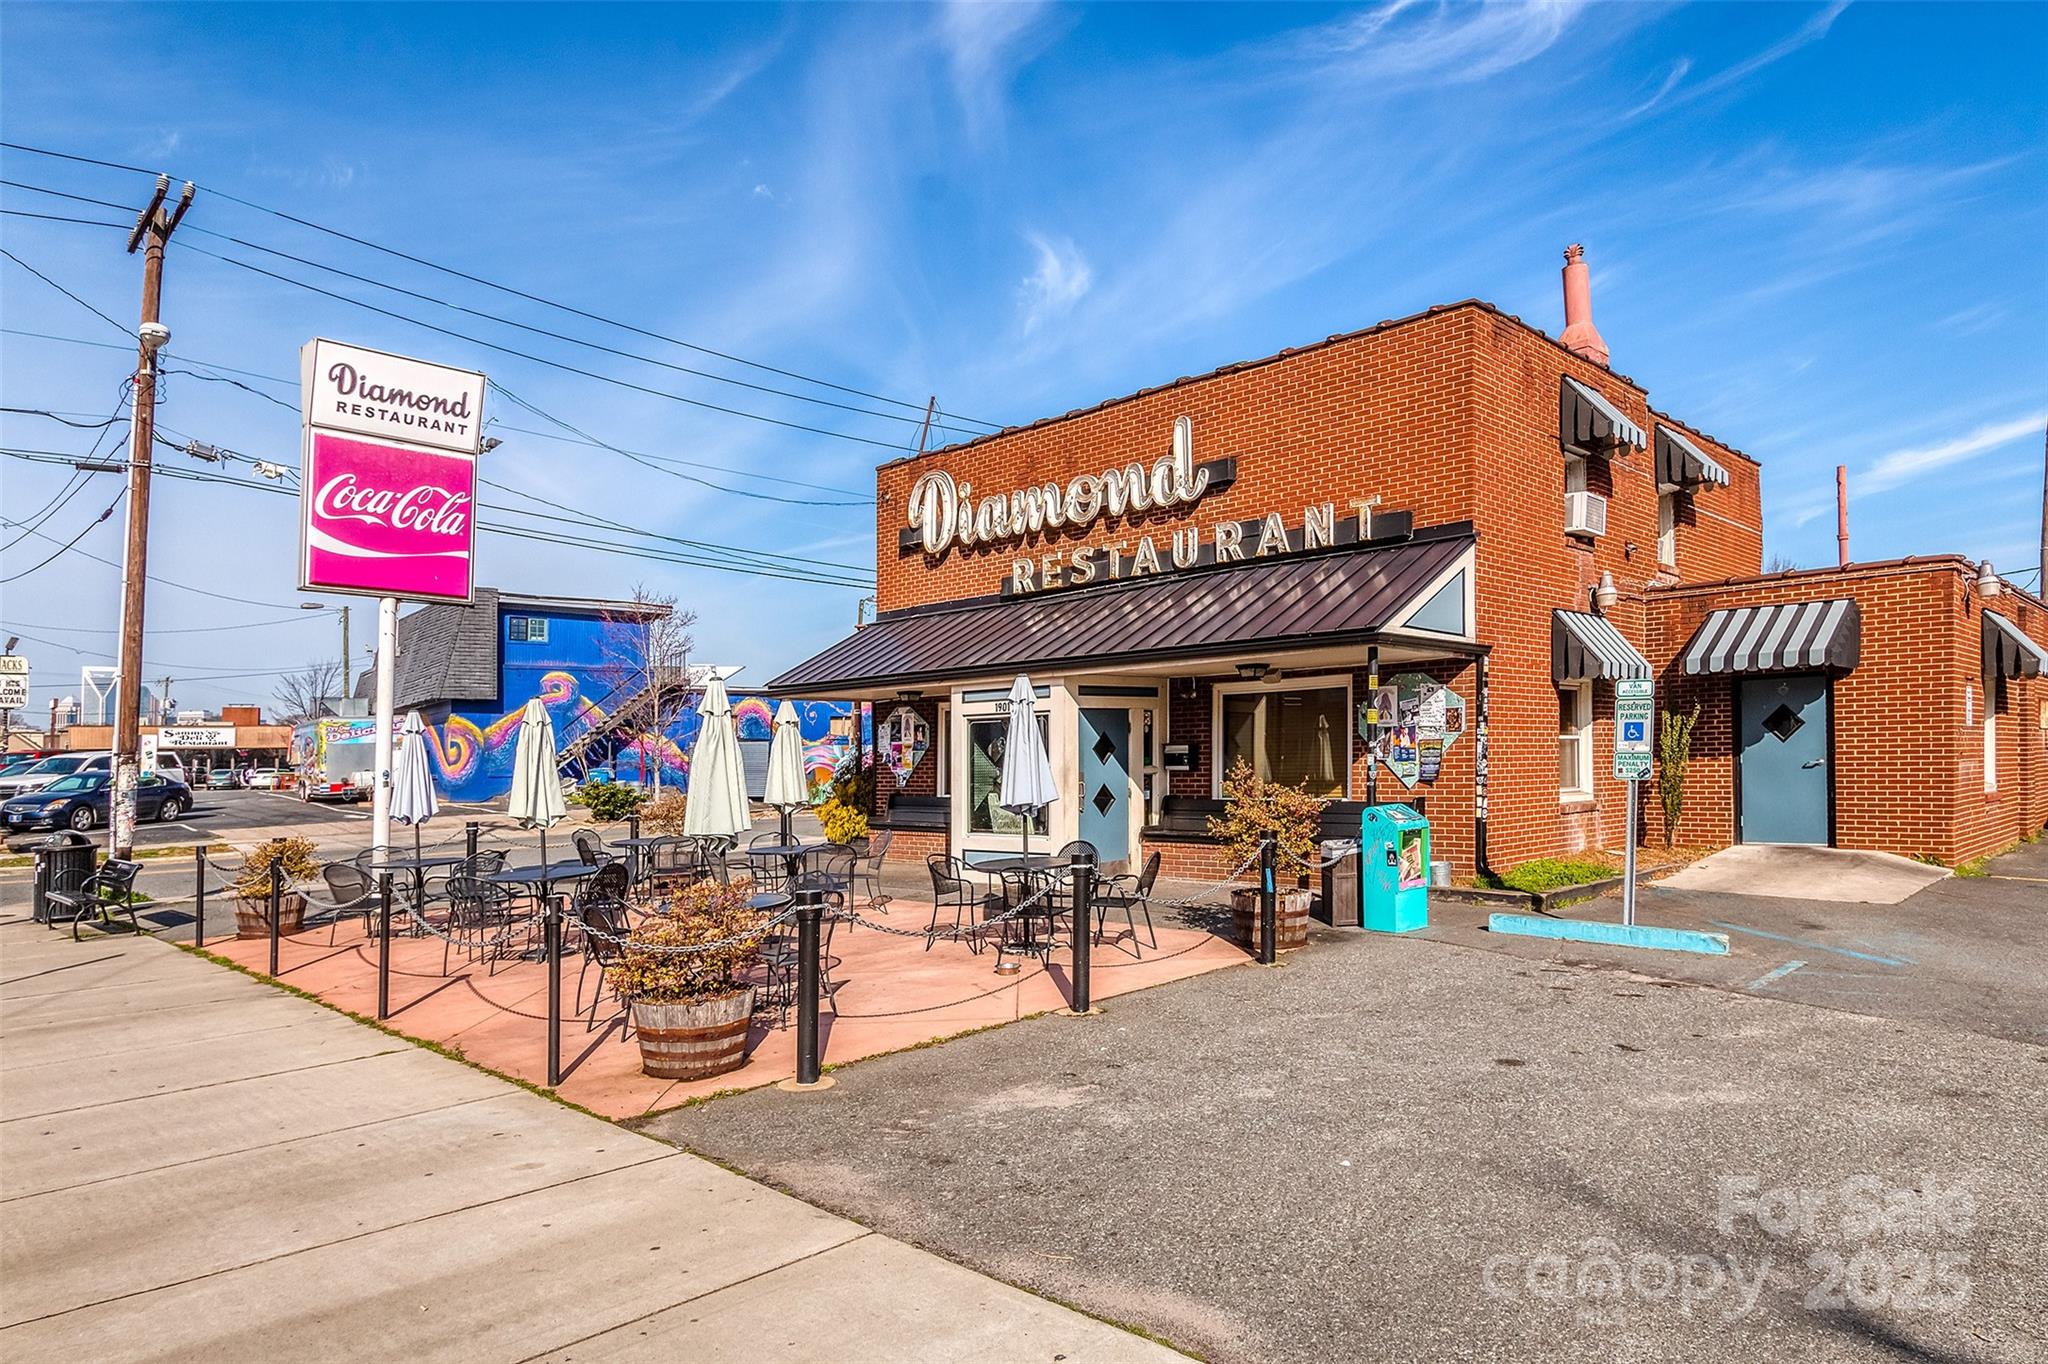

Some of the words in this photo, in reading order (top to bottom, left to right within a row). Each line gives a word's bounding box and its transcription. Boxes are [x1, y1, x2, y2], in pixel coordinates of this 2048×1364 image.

[328, 362, 471, 419] Diamond
[336, 401, 468, 436] RESTAURANT
[907, 415, 1210, 555] Diamond
[1012, 494, 1382, 595] RESTAURANT
[0, 659, 23, 670] ACKS
[0, 688, 27, 696] COME
[995, 702, 1011, 712] 1901
[1618, 703, 1651, 711] RESERVED
